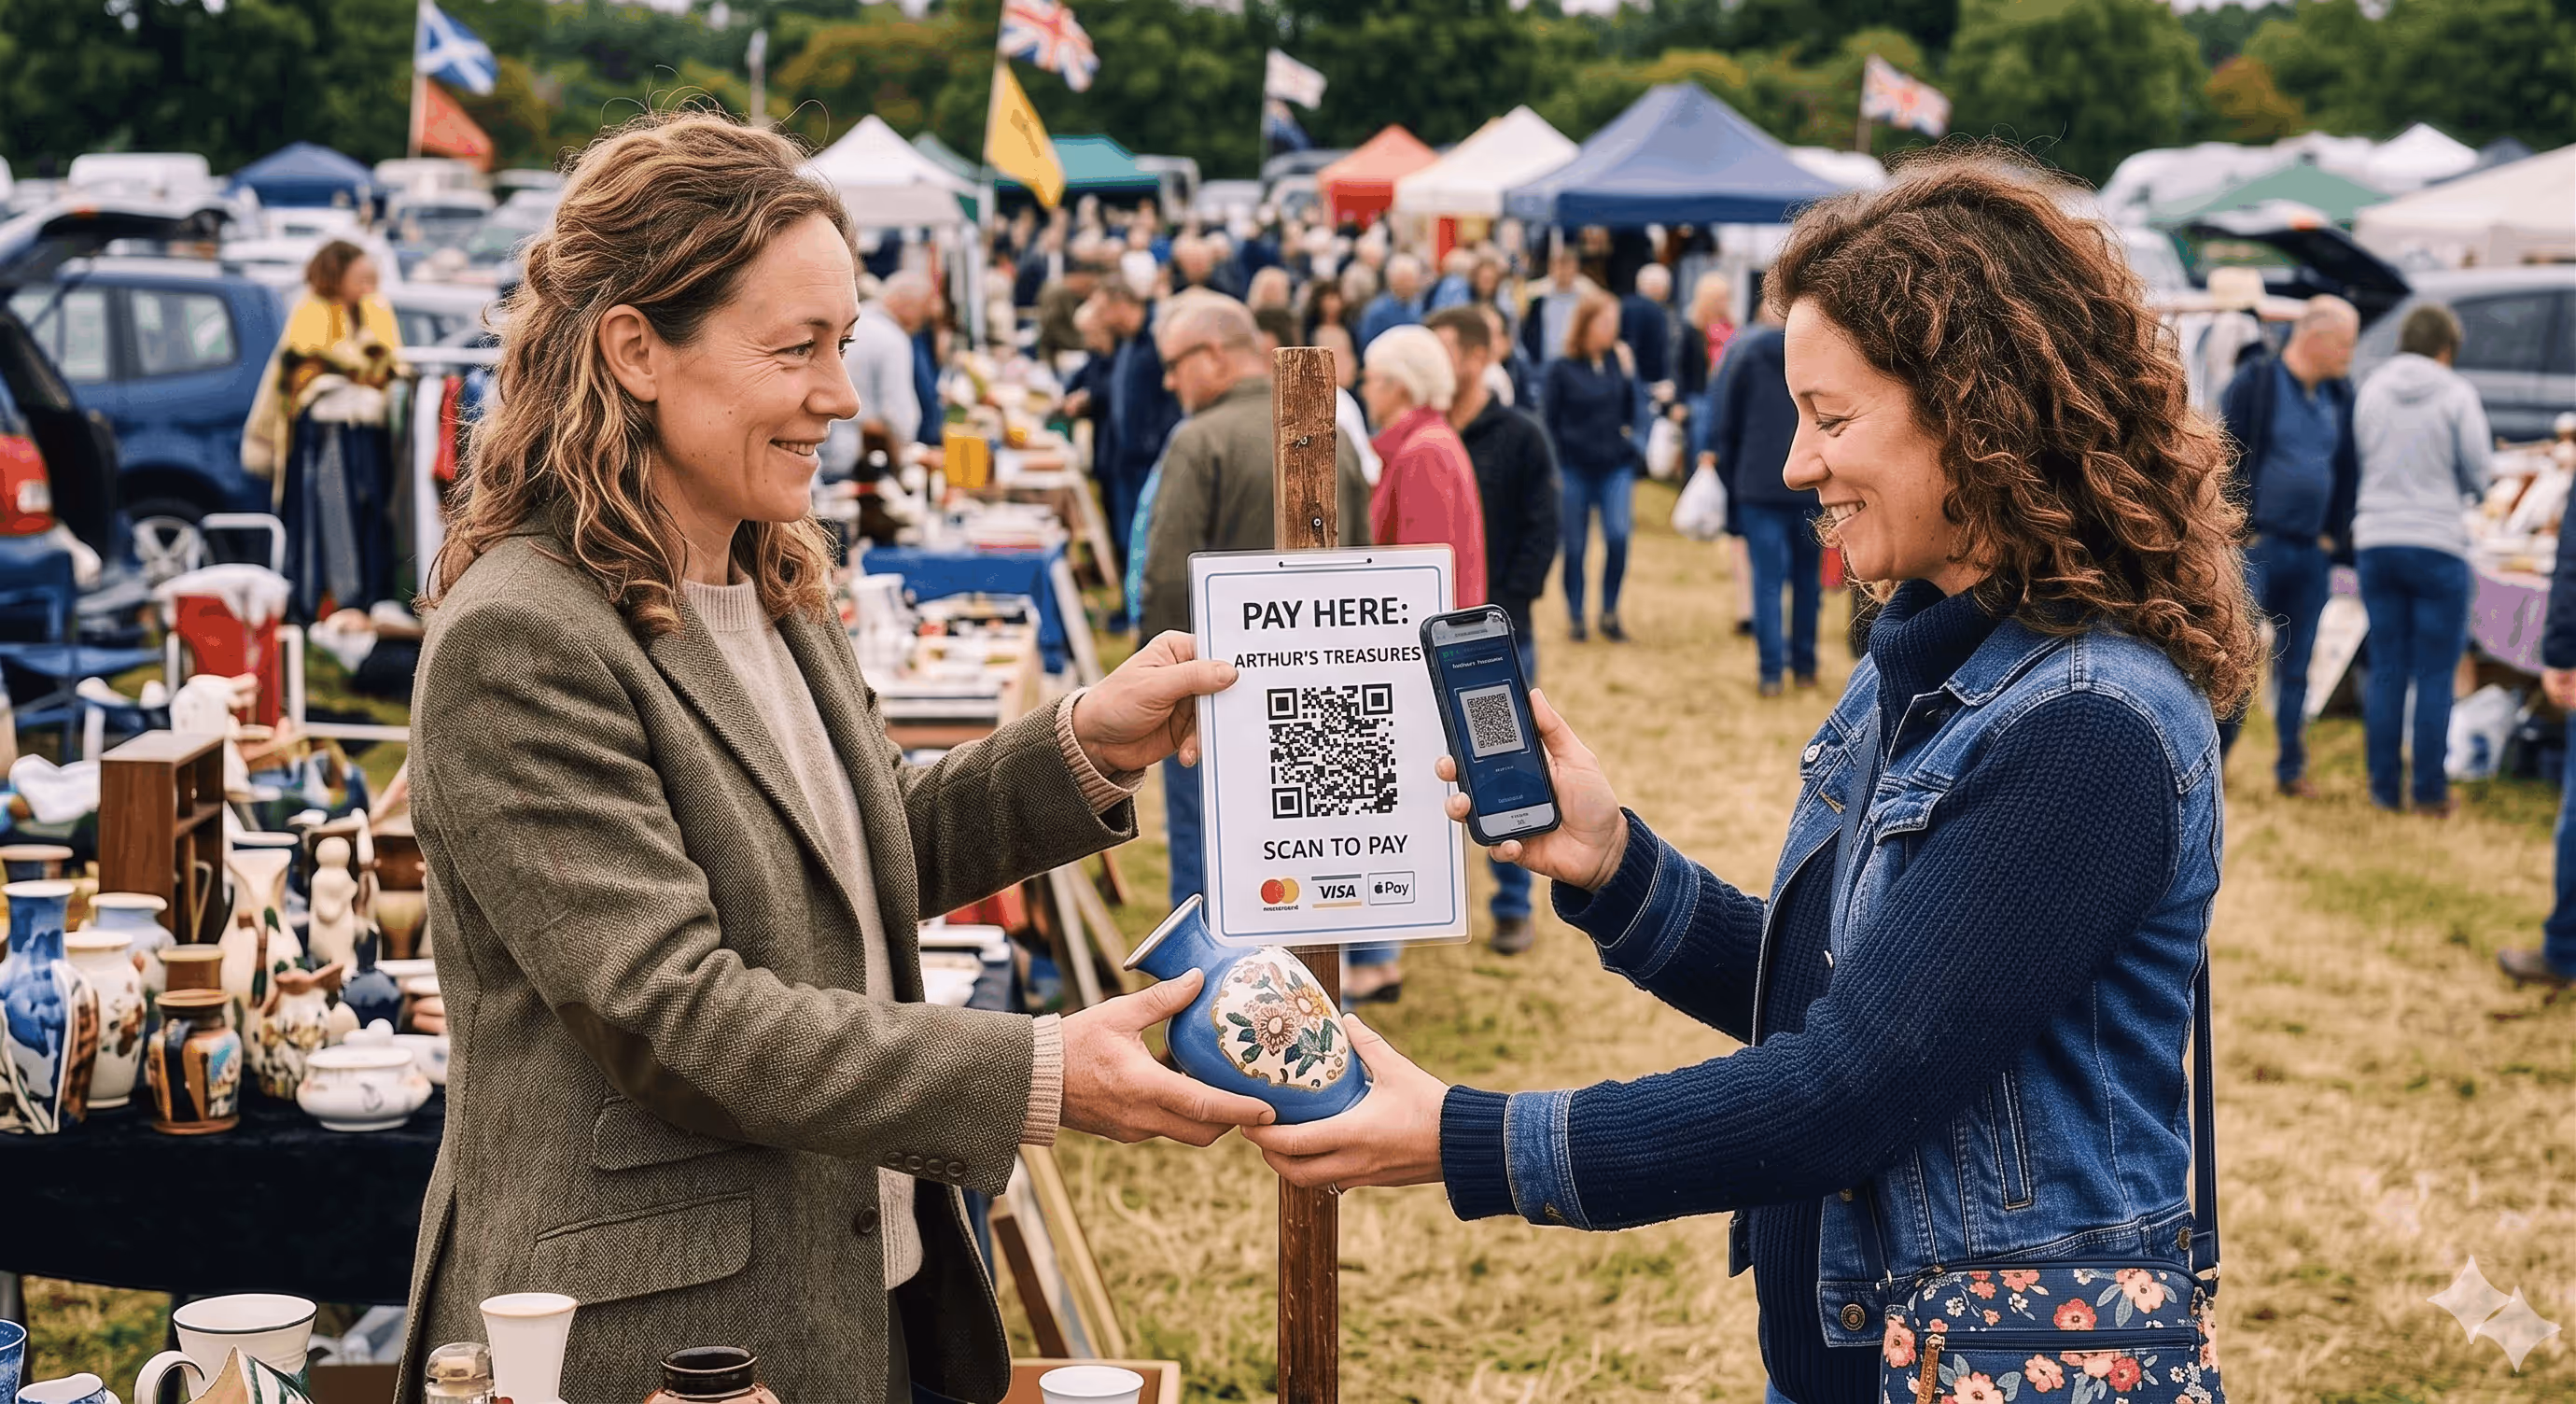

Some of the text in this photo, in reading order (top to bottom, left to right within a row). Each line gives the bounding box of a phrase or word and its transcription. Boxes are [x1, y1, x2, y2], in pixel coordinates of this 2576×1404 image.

[1243, 597, 1408, 630] PAY HERE:
[1234, 651, 1319, 668] ARTHUR'S
[1323, 646, 1421, 665] TREASURES
[1264, 834, 1408, 861] SCAN TO PAY
[1318, 885, 1356, 899] VISA
[1385, 881, 1409, 896] Pay
